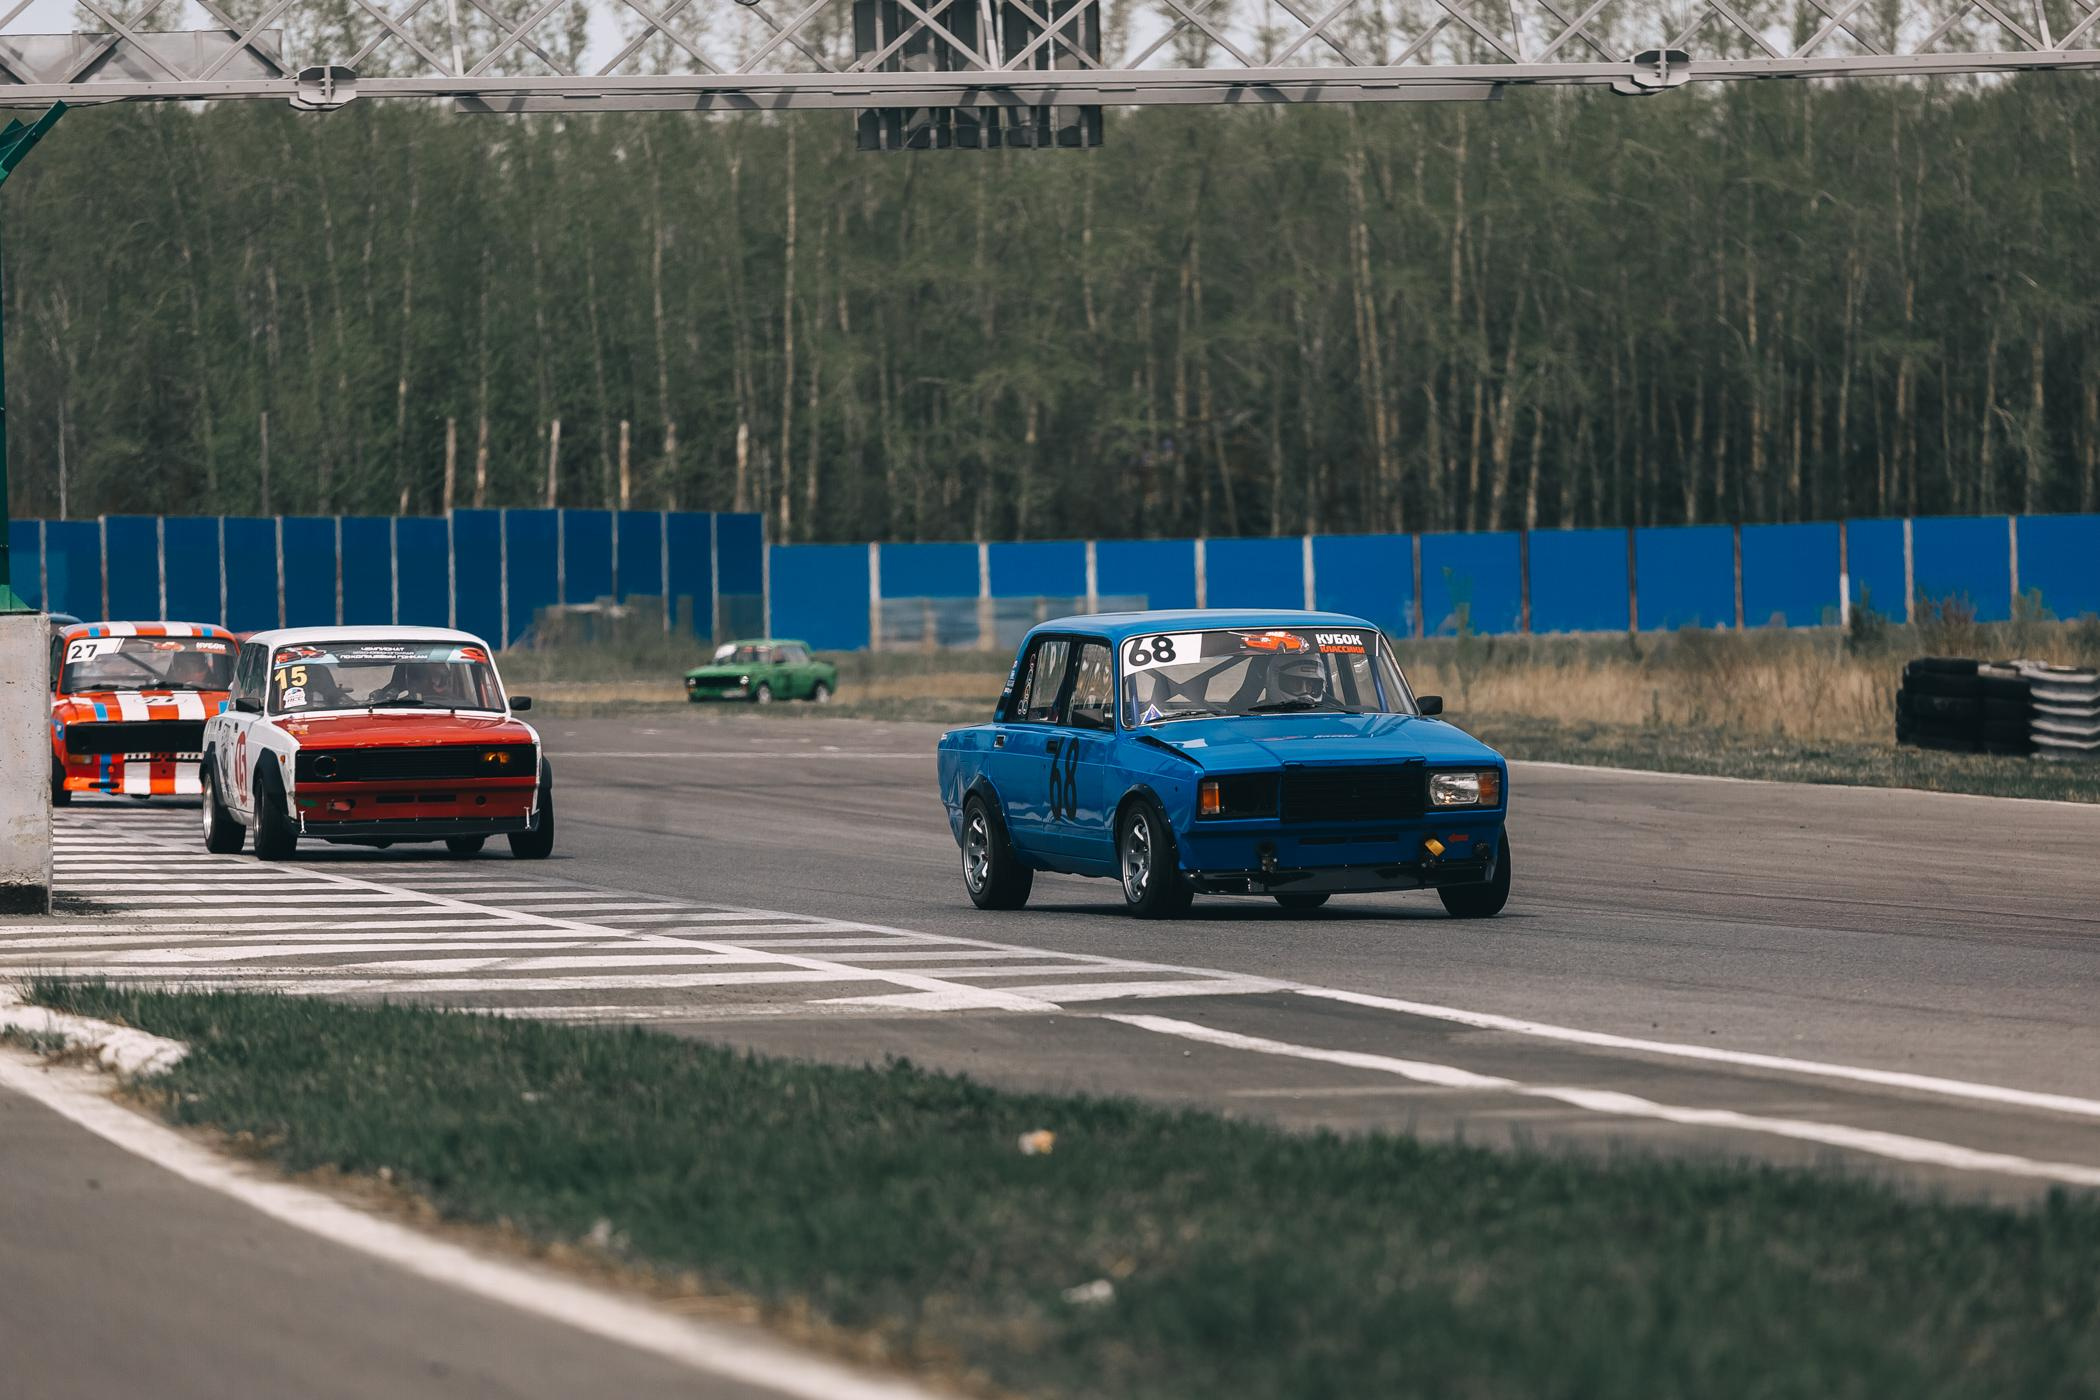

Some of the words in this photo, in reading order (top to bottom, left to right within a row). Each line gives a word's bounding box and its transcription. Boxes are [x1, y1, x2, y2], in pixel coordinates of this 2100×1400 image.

[71, 644, 98, 659] 27
[1128, 635, 1176, 667] 68
[1315, 633, 1363, 646] КУБОК
[274, 665, 308, 690] 15
[1051, 736, 1080, 821] 68
